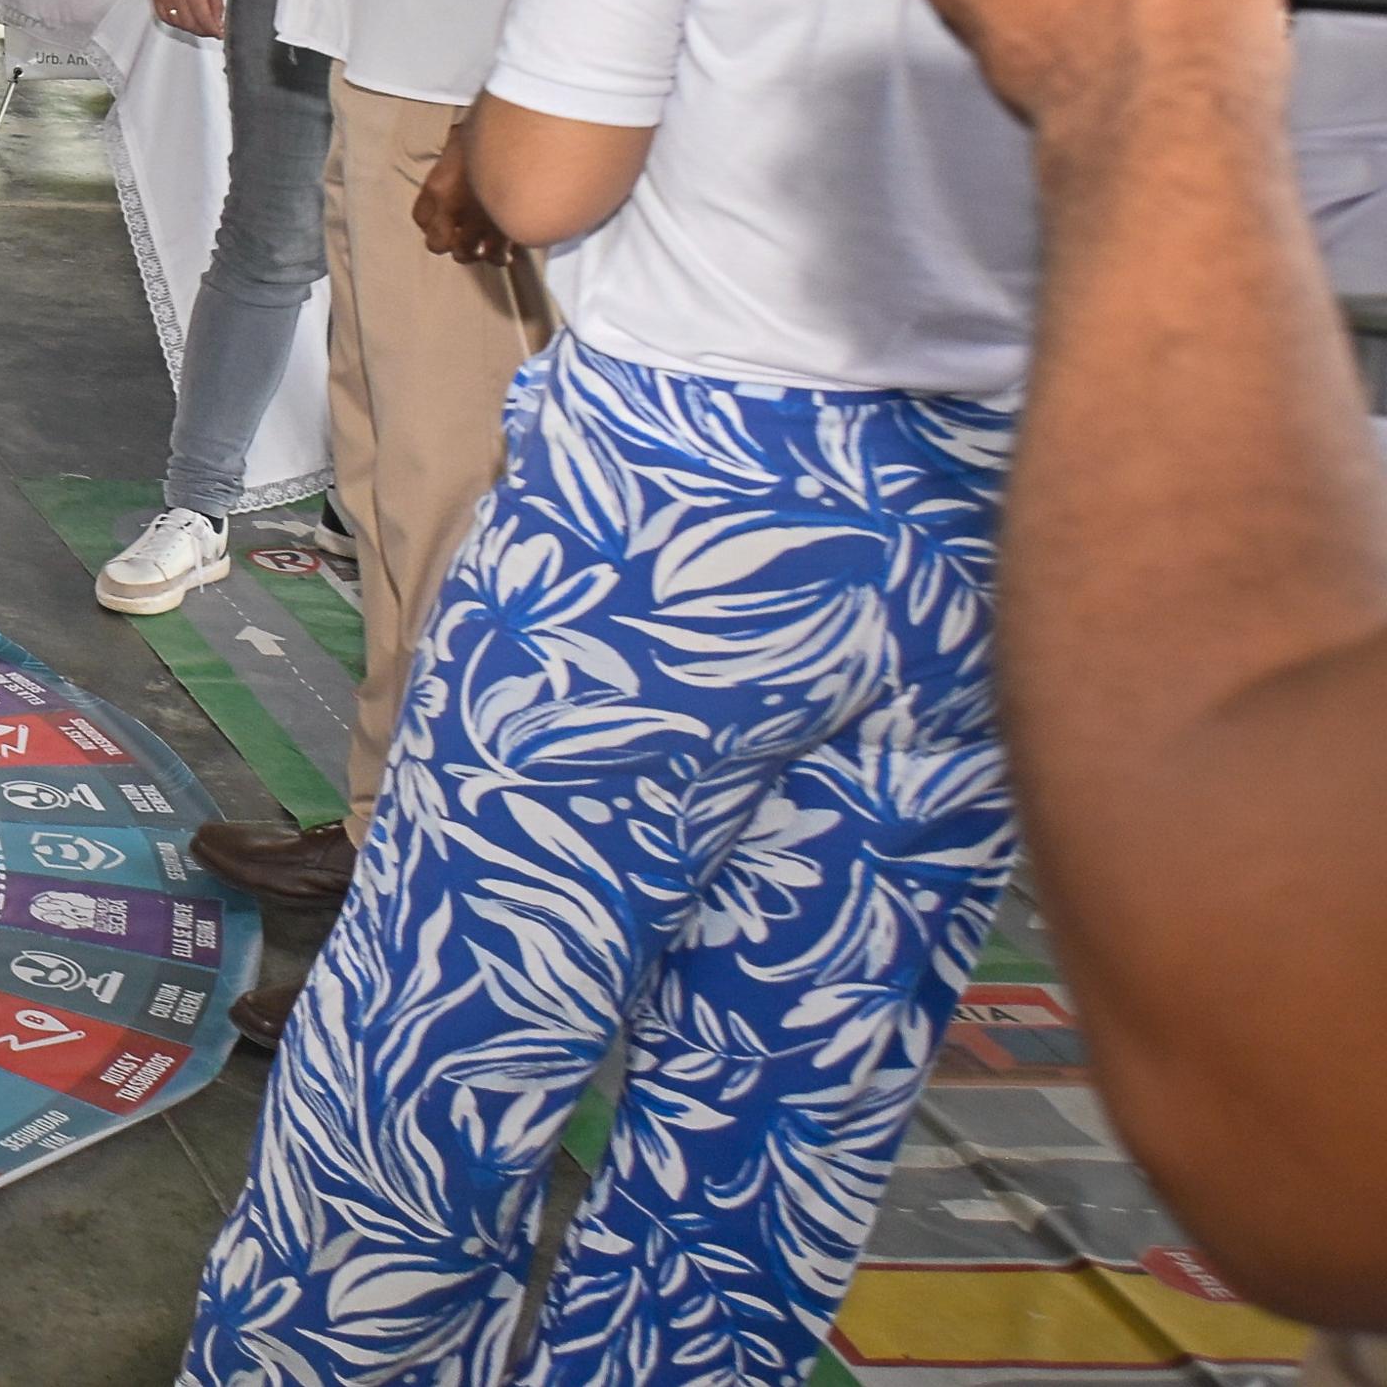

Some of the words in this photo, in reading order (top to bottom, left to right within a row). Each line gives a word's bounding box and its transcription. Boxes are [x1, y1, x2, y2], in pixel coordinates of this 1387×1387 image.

[172, 902, 194, 928] MUEVE
[172, 939, 193, 958] ELLA
[196, 920, 216, 949] SEGURA
[148, 983, 182, 1019] CULTURA
[173, 989, 206, 1025] GENERAL
[25, 1015, 46, 1025] B
[100, 1053, 134, 1086] RUTAS
[131, 1053, 144, 1064] Y
[115, 1052, 176, 1102] TRASBORDOS
[0, 1110, 71, 1152] SEGURIDAD
[38, 1131, 77, 1151] VIAL
